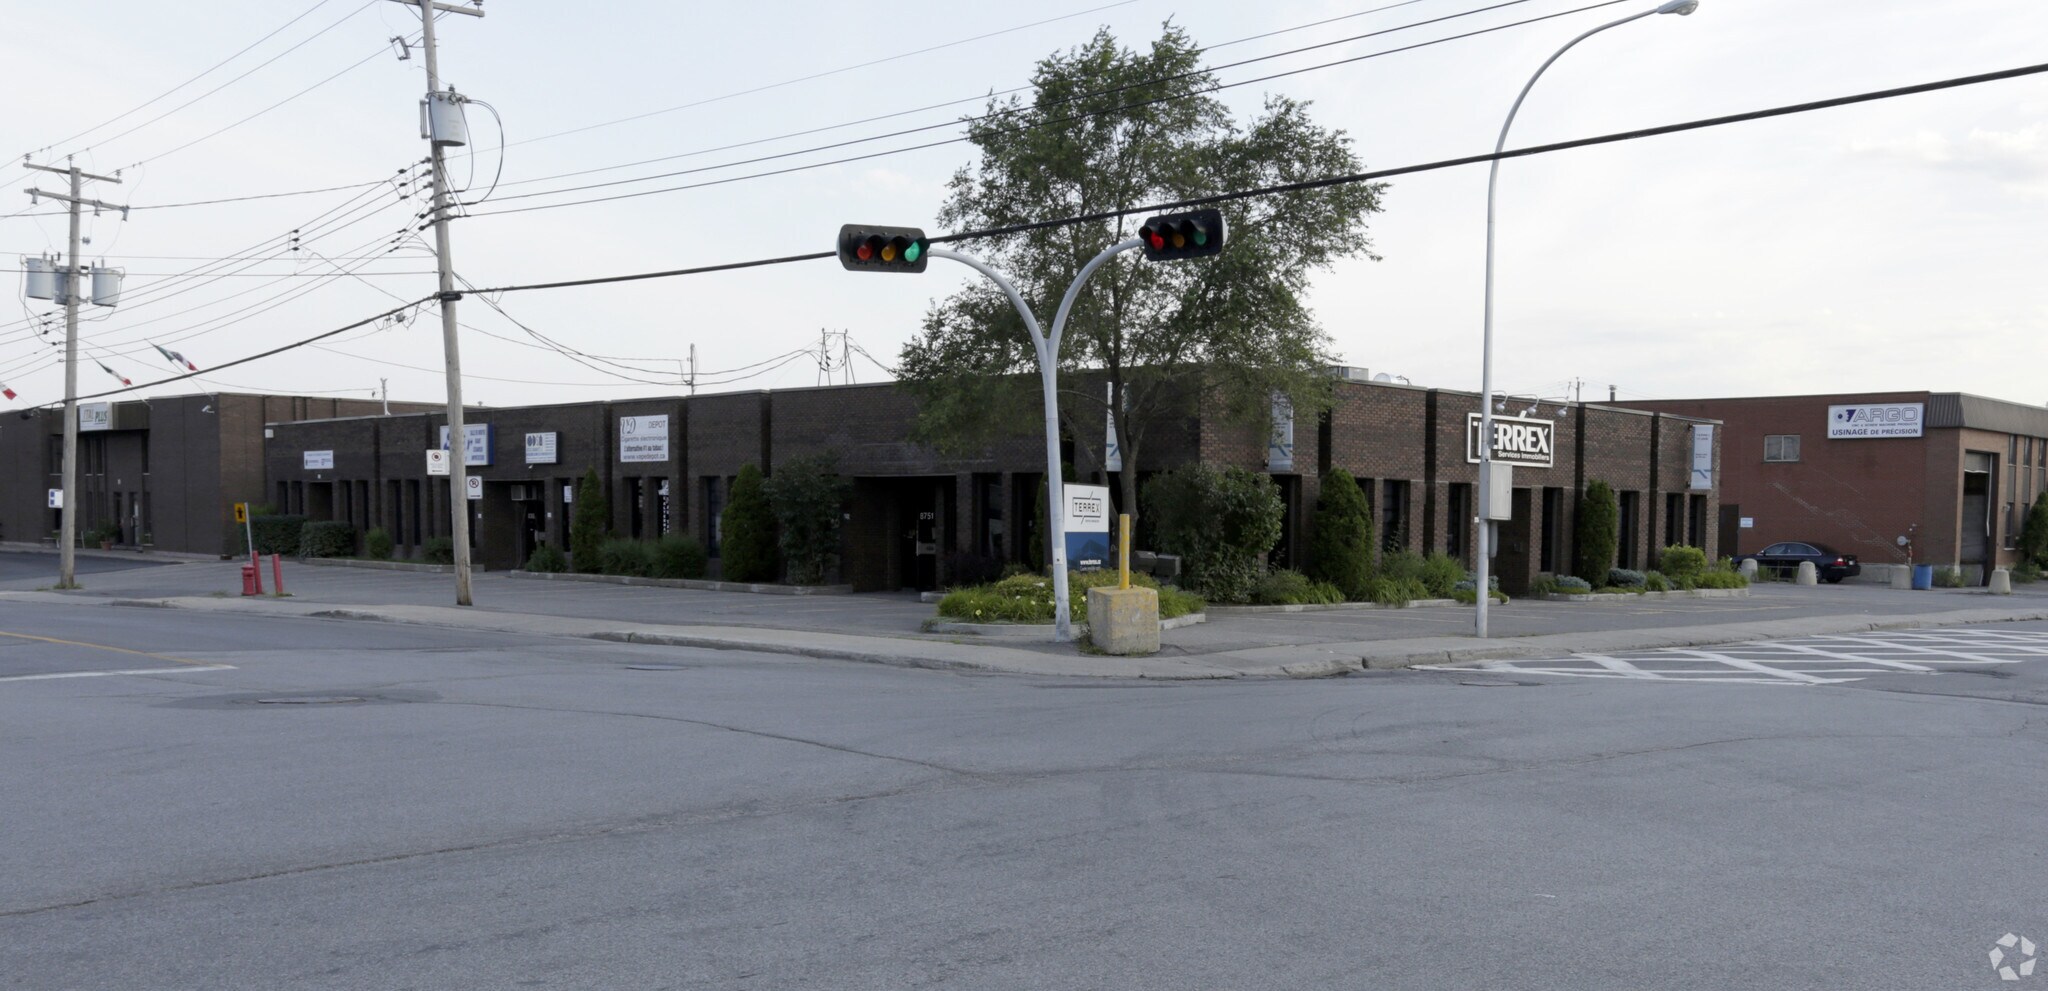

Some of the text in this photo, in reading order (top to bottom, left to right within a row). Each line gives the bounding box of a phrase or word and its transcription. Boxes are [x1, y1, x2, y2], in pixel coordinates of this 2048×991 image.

[1853, 407, 1918, 422] ARGO
[648, 420, 666, 429] DEPOT
[1832, 428, 1868, 436] USINAGE
[1881, 427, 1919, 435] PRÉCISION
[1497, 450, 1521, 459] Services
[1074, 502, 1100, 513] TERREX
[919, 511, 934, 520] 8751
